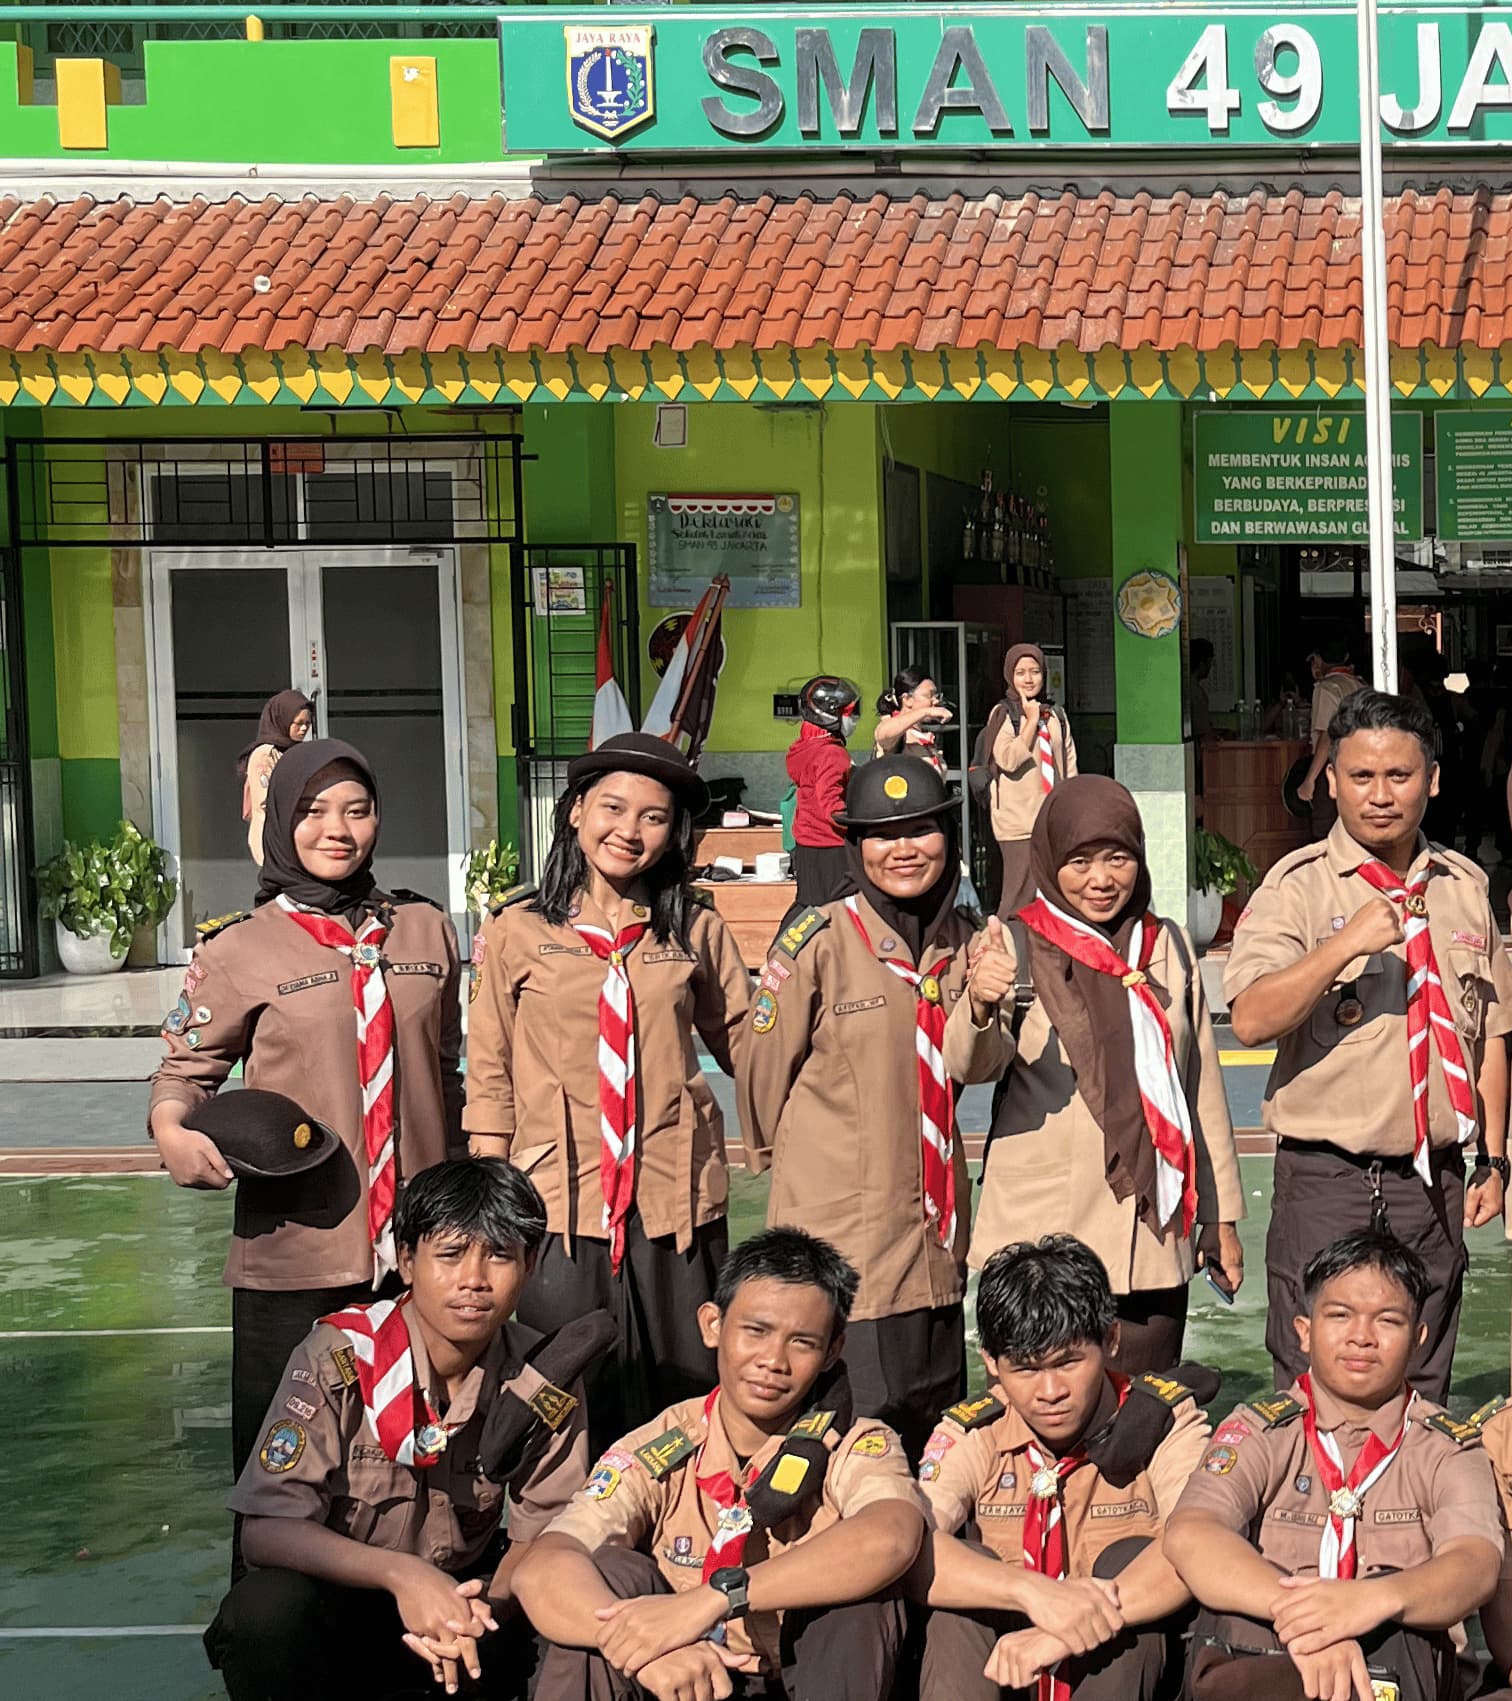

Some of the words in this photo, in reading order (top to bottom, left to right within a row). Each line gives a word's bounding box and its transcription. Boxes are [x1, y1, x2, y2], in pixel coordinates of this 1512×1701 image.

[577, 33, 604, 43] JAYA
[609, 33, 641, 43] RAYA
[701, 26, 1110, 138] SMAN
[1166, 23, 1323, 132] 49
[1272, 417, 1351, 444] VISI
[1208, 454, 1301, 467] MEMBENTUK
[1305, 454, 1350, 467] INSAN
[1222, 476, 1262, 490] YANG
[1214, 499, 1303, 514] BERBUDAYA,
[1211, 521, 1240, 534] DAN
[1245, 521, 1347, 534] BERWAWASAN
[1352, 521, 1409, 534] GLAL
